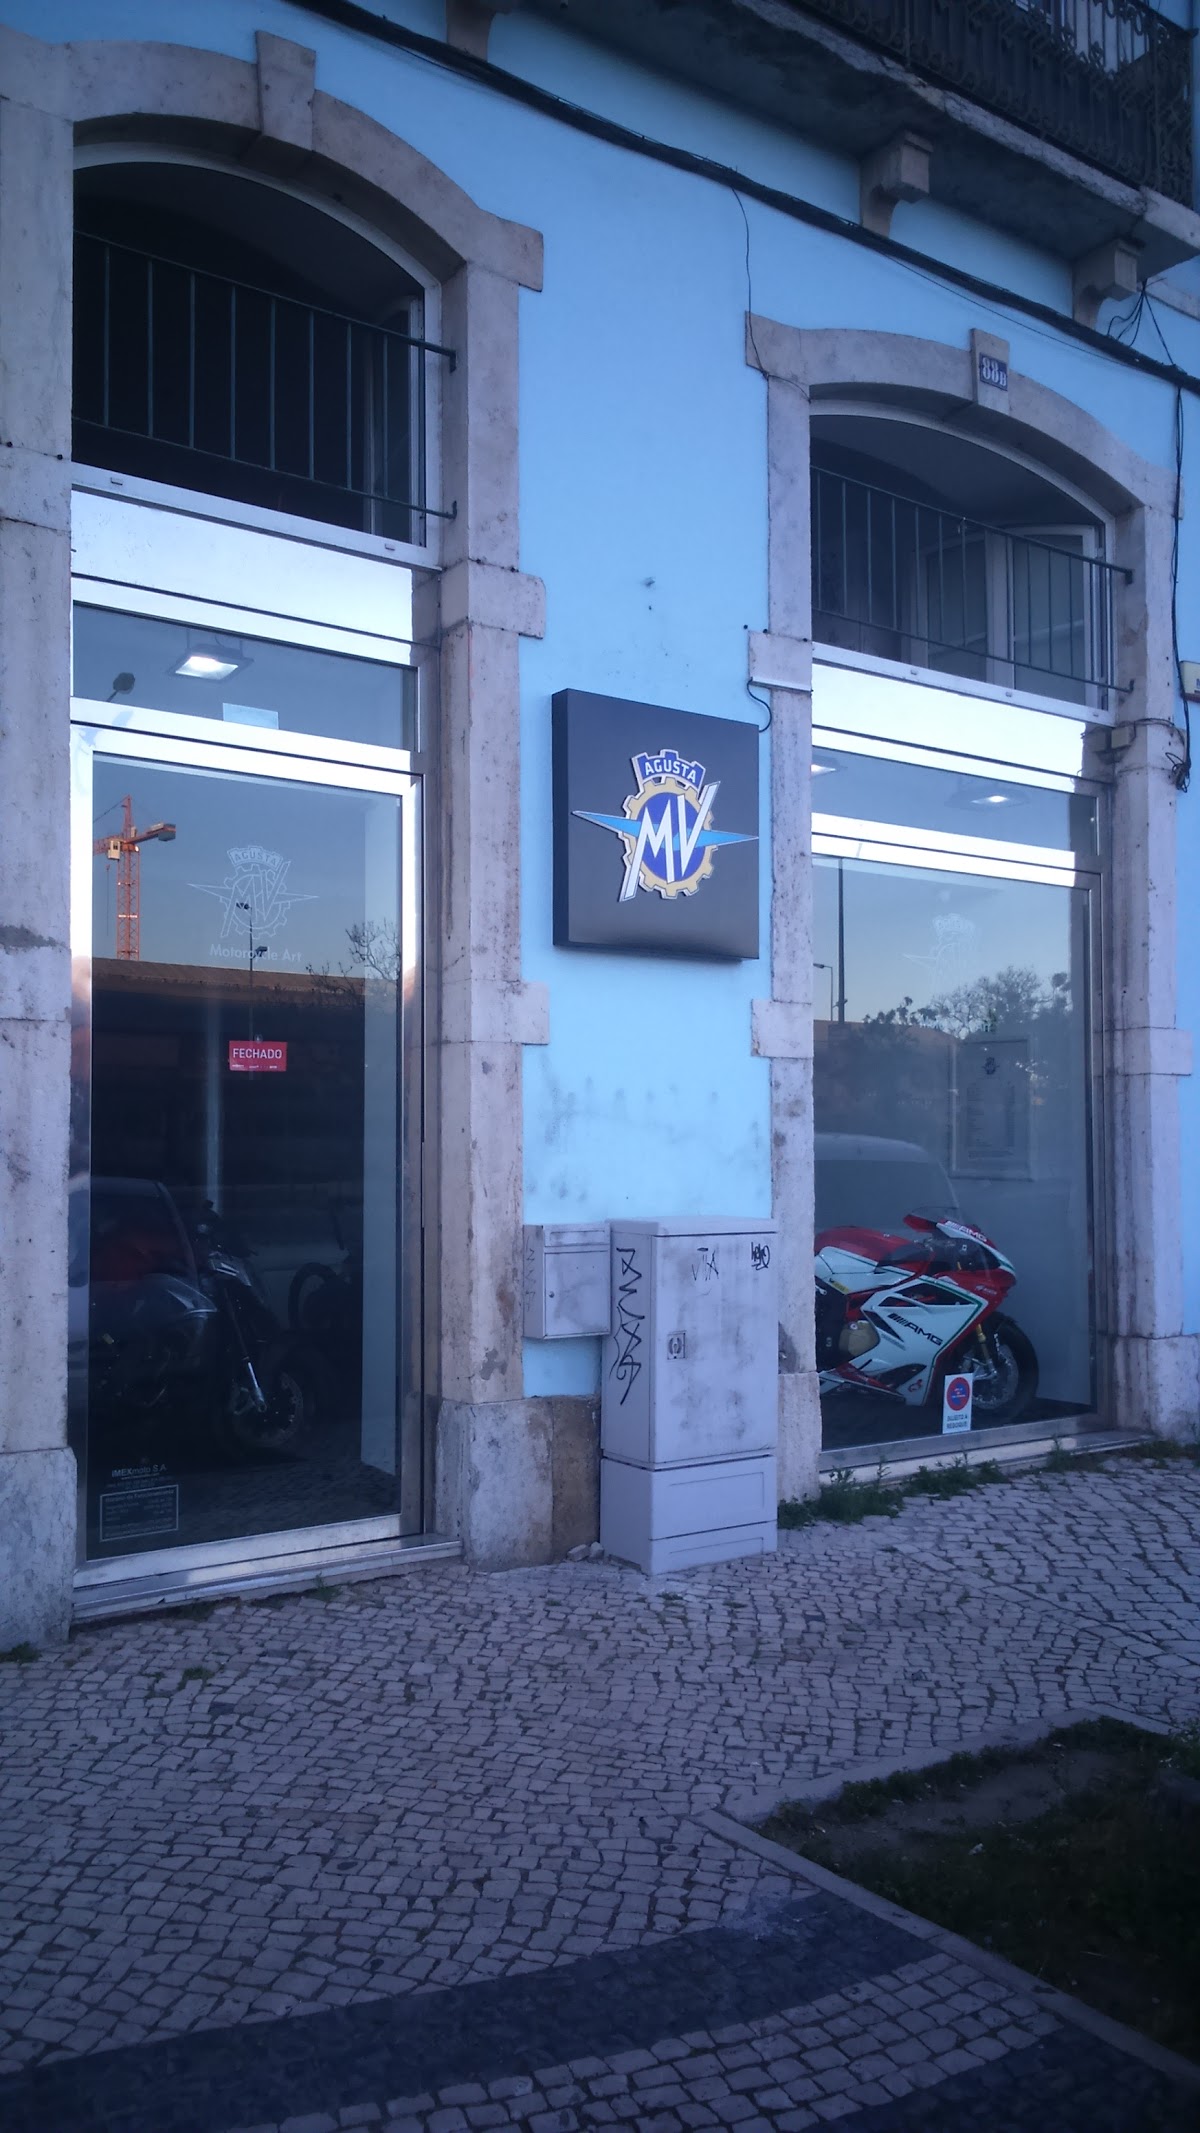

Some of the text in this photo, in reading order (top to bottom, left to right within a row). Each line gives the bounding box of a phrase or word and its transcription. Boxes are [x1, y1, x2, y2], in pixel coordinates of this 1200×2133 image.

[644, 758, 698, 784] AGUSTA
[619, 781, 721, 902] MV
[232, 1047, 283, 1060] FECHADO
